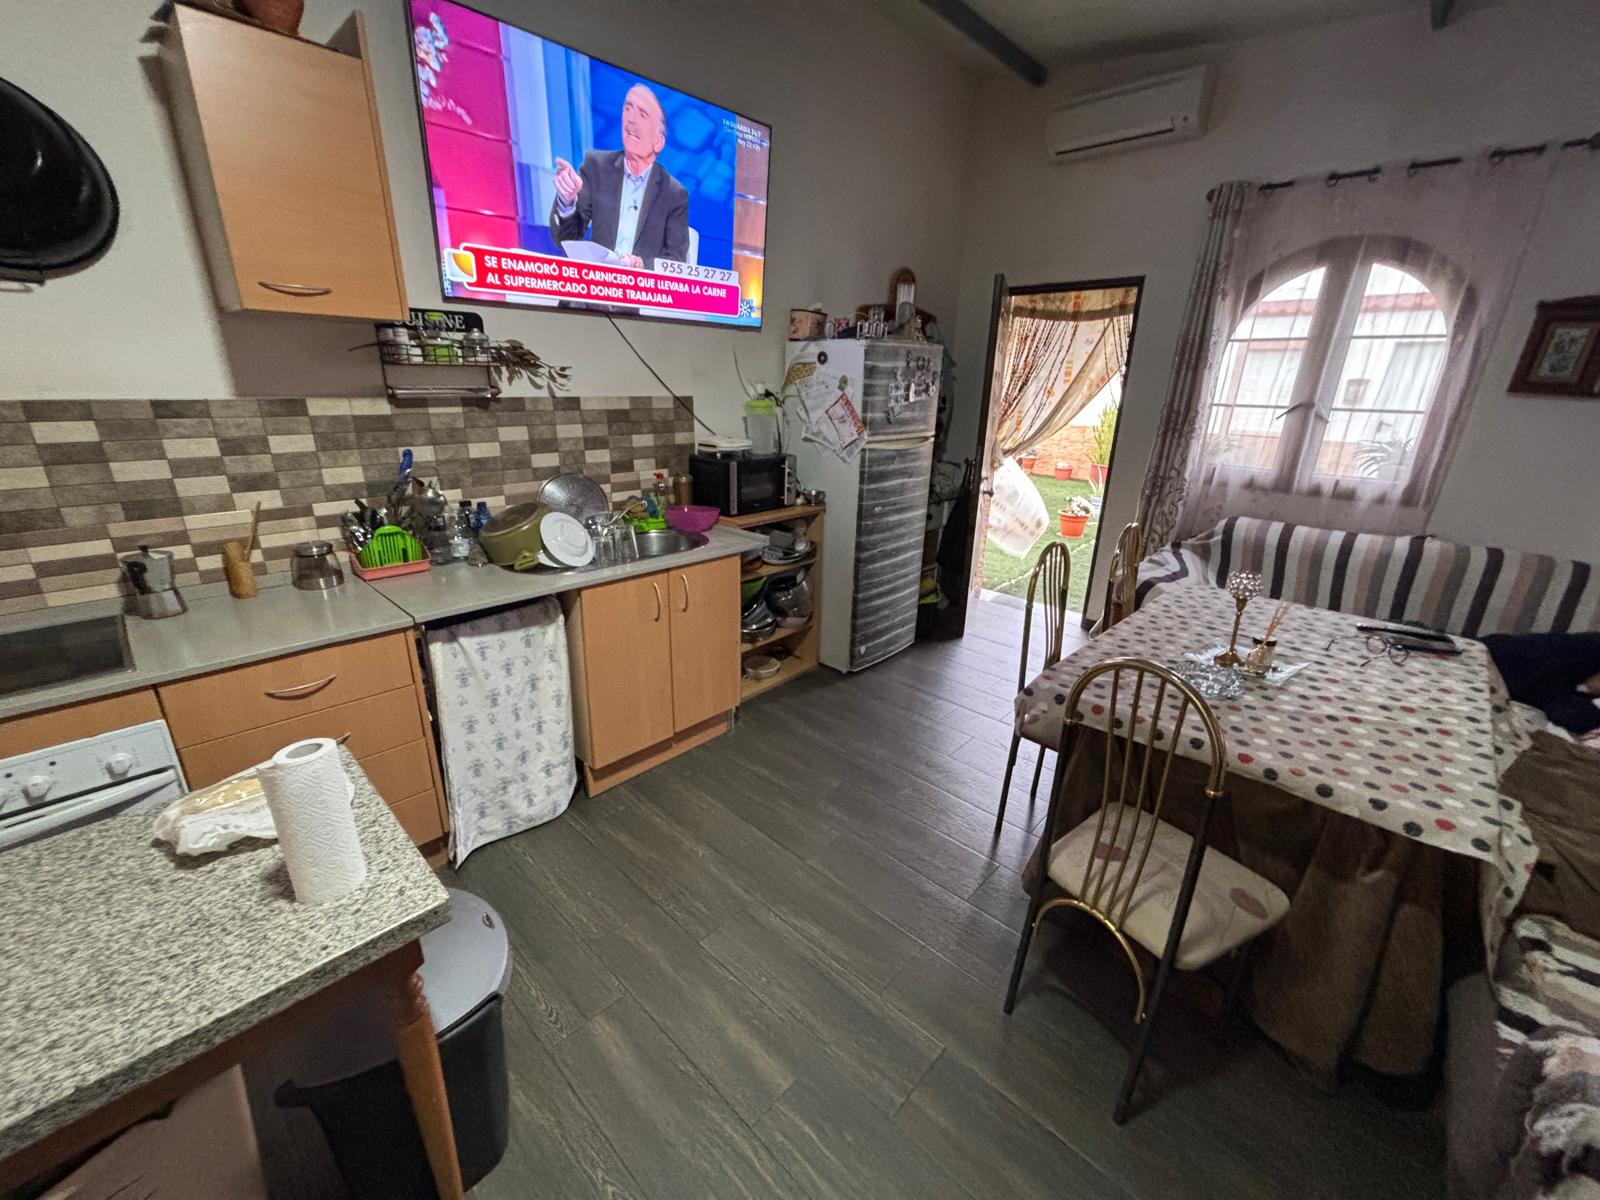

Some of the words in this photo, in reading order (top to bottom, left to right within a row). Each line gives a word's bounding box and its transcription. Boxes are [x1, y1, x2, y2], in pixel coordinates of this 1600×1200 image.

[484, 255, 498, 268] SE
[501, 257, 559, 275] ENAMORÓ
[562, 266, 579, 279] DEL
[582, 269, 635, 286] CARNICERO
[637, 277, 655, 288] QUE
[657, 279, 690, 294] LLEVABA
[692, 285, 701, 294] LA
[702, 287, 727, 298] CARNE
[661, 261, 683, 274] 955
[687, 265, 700, 278] 25
[704, 268, 717, 280] 27
[719, 271, 732, 282] 27
[486, 272, 501, 285] AL
[504, 274, 587, 294] SUPERMERCADO
[590, 285, 623, 298] DONDE
[625, 289, 673, 304] TRABAJABA
